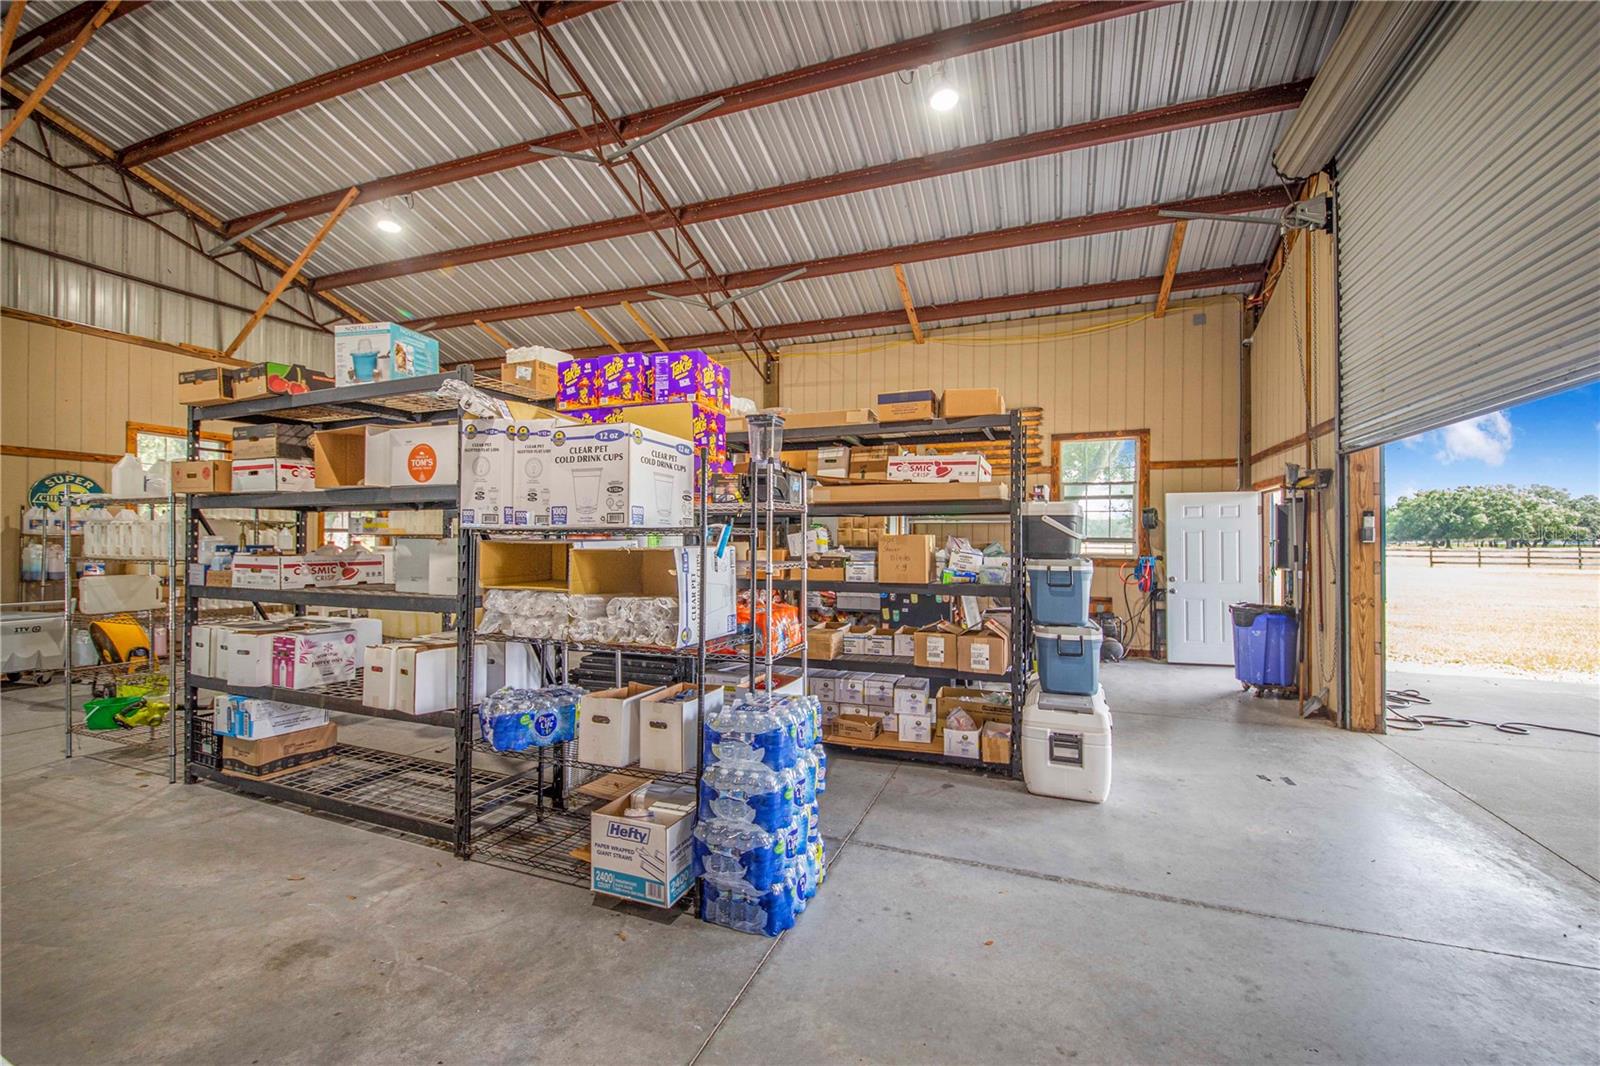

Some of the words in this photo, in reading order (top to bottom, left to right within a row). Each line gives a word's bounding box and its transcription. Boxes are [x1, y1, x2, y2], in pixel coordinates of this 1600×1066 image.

[600, 432, 608, 440] 12
[569, 446, 593, 454] CLEAR
[594, 445, 608, 453] PET
[651, 450, 668, 459] CLEAR
[411, 459, 433, 467] TOM'S
[555, 456, 575, 464] COLD
[577, 455, 601, 463] DRINK
[603, 453, 624, 461] CUPS
[640, 456, 656, 466] COLD
[656, 460, 673, 470] DRINK
[673, 464, 687, 472] CUPS
[45, 475, 94, 489] SUPER
[609, 823, 647, 844] Hefty
[595, 842, 610, 850] PAPER
[611, 846, 635, 855] WRAPPED
[596, 849, 611, 857] GIANT
[613, 853, 632, 862] STRAWS
[595, 870, 613, 883] 2400
[671, 870, 689, 893] 2400
